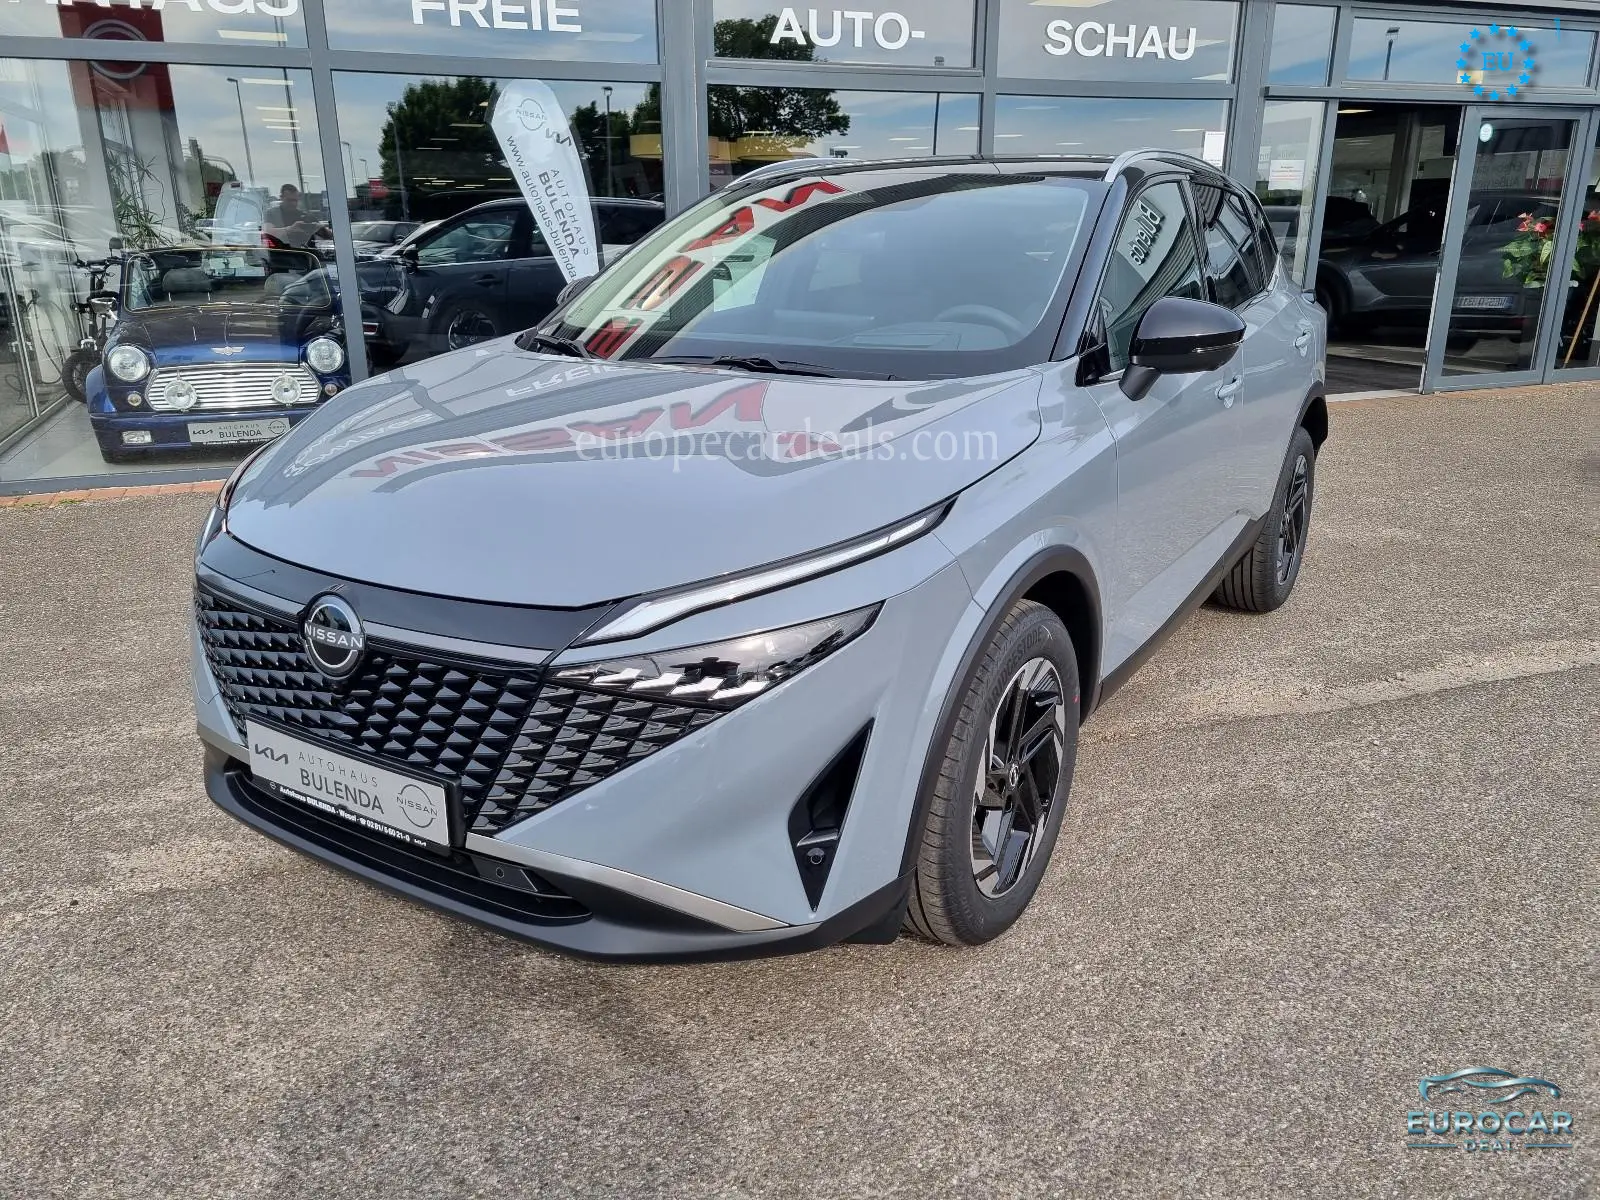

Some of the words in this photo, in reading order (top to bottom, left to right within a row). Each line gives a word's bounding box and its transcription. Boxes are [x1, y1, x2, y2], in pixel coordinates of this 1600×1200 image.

[411, 0, 582, 33] FREIE
[770, 7, 925, 50] AUTO-
[1043, 19, 1197, 60] SCHAU
[538, 171, 580, 260] BULENDA
[550, 169, 589, 256] AUTOHAUS
[219, 429, 263, 439] BULENDA
[304, 622, 363, 648] NISSAN
[298, 751, 378, 788] AUTOHAUS
[299, 767, 385, 815] BULENDA
[396, 795, 438, 817] NISSAN
